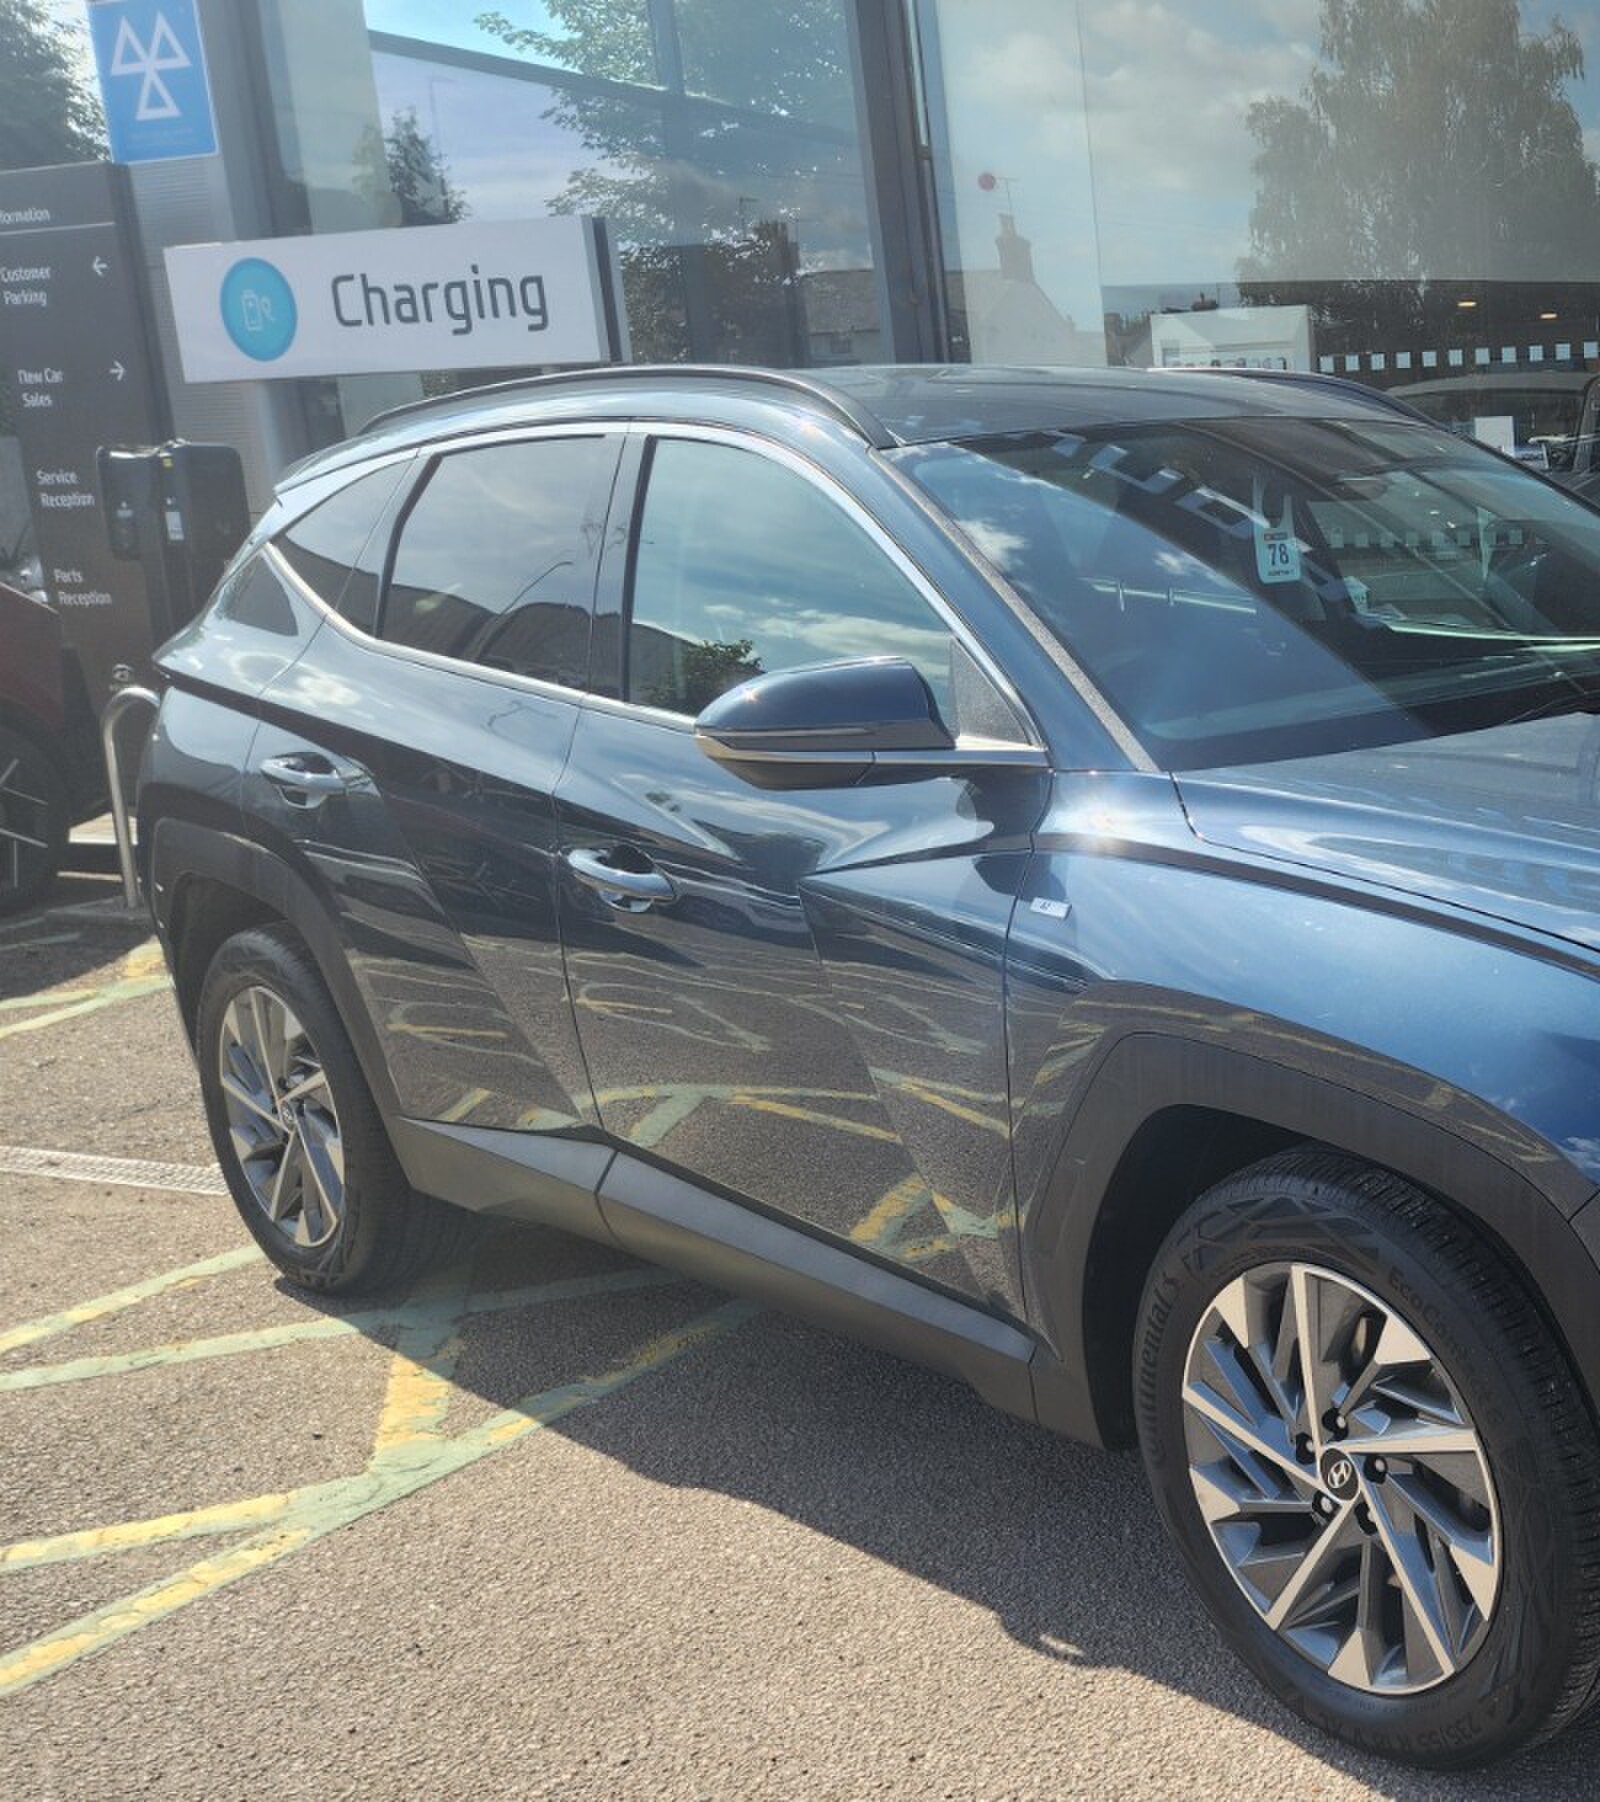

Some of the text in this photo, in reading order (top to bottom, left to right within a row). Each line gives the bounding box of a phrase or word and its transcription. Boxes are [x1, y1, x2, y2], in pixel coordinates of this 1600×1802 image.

[0, 266, 50, 282] Customer
[3, 289, 47, 307] Parking
[331, 264, 549, 336] Charging
[17, 367, 63, 384] New Car
[22, 391, 52, 408] Sales
[36, 468, 78, 485] Service
[40, 492, 95, 508] Reception
[1267, 543, 1290, 566] 78
[54, 567, 83, 583] Parts
[58, 590, 112, 607] Reception
